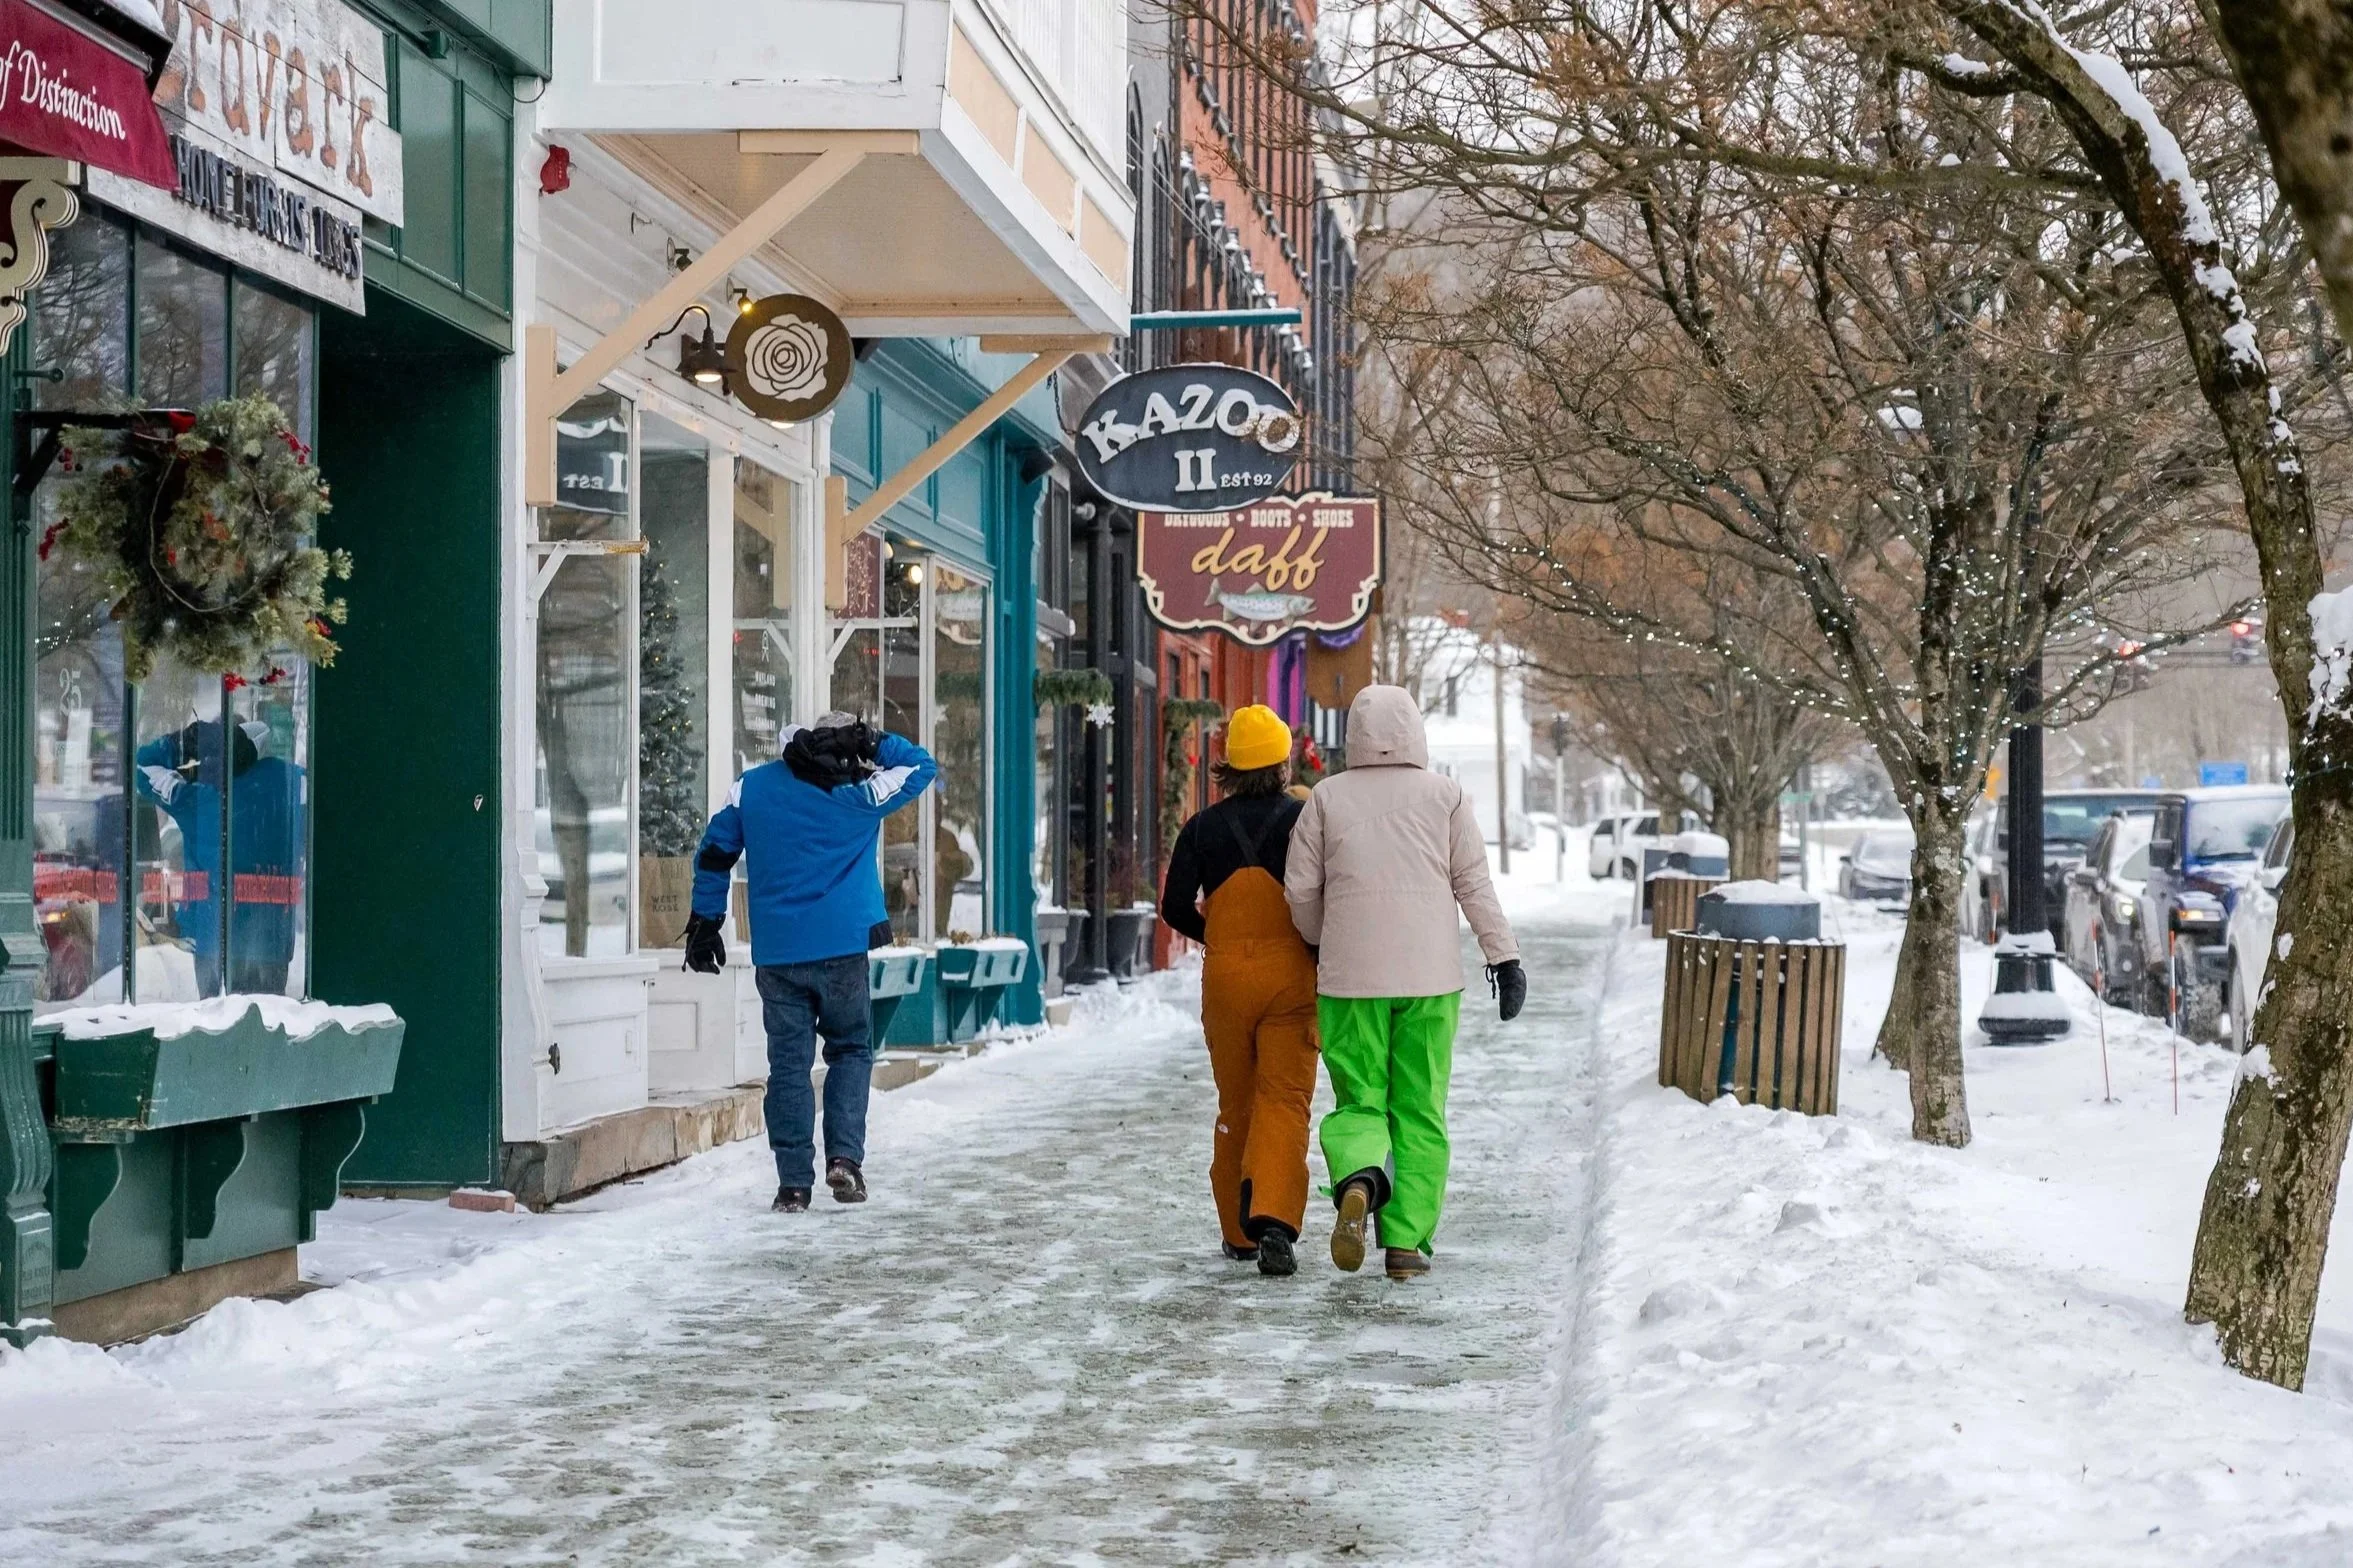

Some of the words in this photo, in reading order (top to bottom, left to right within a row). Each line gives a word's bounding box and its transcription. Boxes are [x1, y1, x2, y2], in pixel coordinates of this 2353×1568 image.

[18, 49, 126, 140] Distinction
[1081, 383, 1300, 464] KAZOO
[1174, 448, 1217, 492] II
[1220, 471, 1252, 488] EST
[1253, 473, 1273, 486] 92
[1250, 509, 1292, 528] BOOTS
[1312, 509, 1354, 528] SHOES
[1190, 523, 1329, 592] daff
[59, 667, 82, 717] 25
